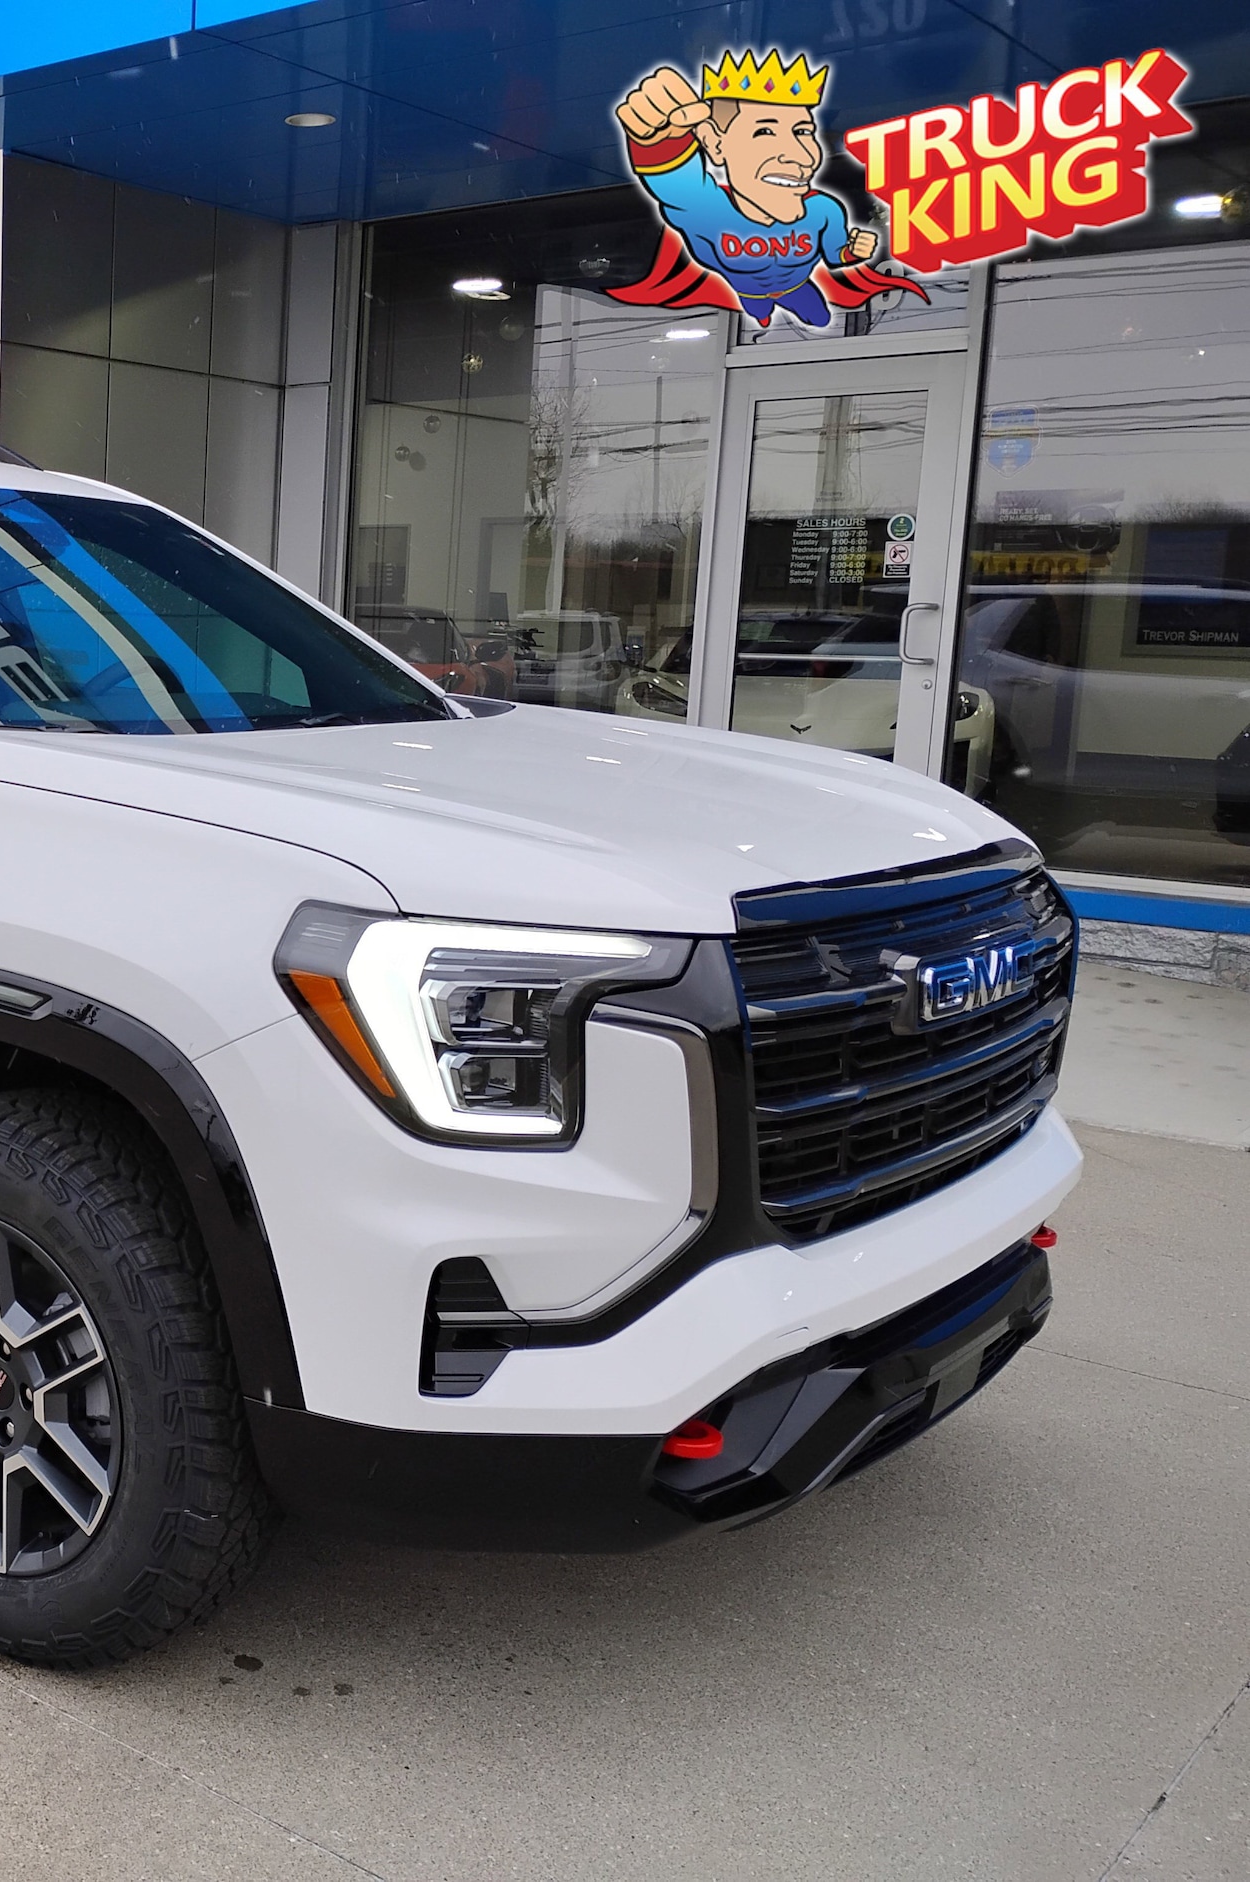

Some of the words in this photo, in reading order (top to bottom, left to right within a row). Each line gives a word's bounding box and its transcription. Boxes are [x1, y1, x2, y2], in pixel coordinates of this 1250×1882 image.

[796, 519, 829, 528] SALES
[830, 518, 866, 527] HOURS
[791, 546, 830, 554] Wednesday
[789, 577, 814, 585] Sunday
[1142, 629, 1186, 641] TREVOR
[1188, 629, 1239, 643] SHIPMAN
[921, 938, 1036, 1021] GMC
